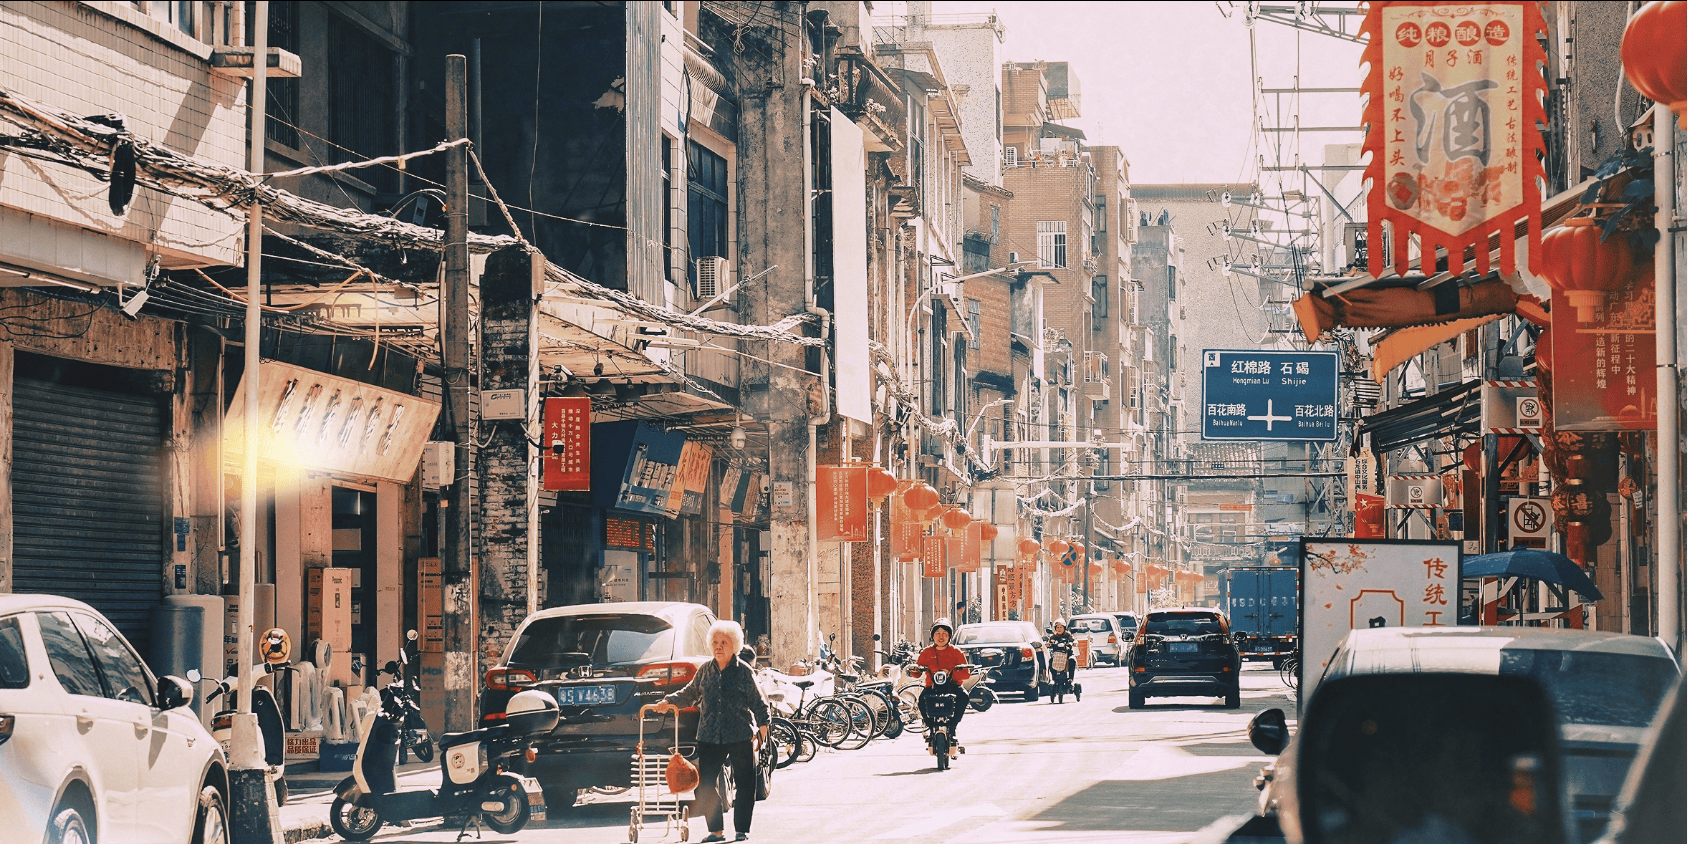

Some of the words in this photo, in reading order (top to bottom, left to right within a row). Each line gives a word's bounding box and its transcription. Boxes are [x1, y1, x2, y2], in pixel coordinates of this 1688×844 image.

[1397, 23, 1510, 45] 纯粮酿造
[1424, 49, 1483, 68] 月子酒
[1388, 65, 1406, 167] 好喝不上头
[1409, 71, 1500, 167] 酒
[1505, 55, 1519, 175] 传统工艺古法酿制
[1609, 291, 1621, 375] 动广东新征程中
[1208, 353, 1216, 361] 西
[1231, 360, 1272, 375] 红棉路
[1280, 361, 1310, 375] 石碣
[1232, 377, 1261, 385] Hongmian
[1262, 377, 1270, 385] Lu
[1281, 377, 1307, 387] Shijie
[1207, 403, 1246, 417] 百花南路
[1294, 404, 1334, 417] 百花北路
[551, 421, 559, 460] 大力
[1422, 557, 1449, 626] 传统工
